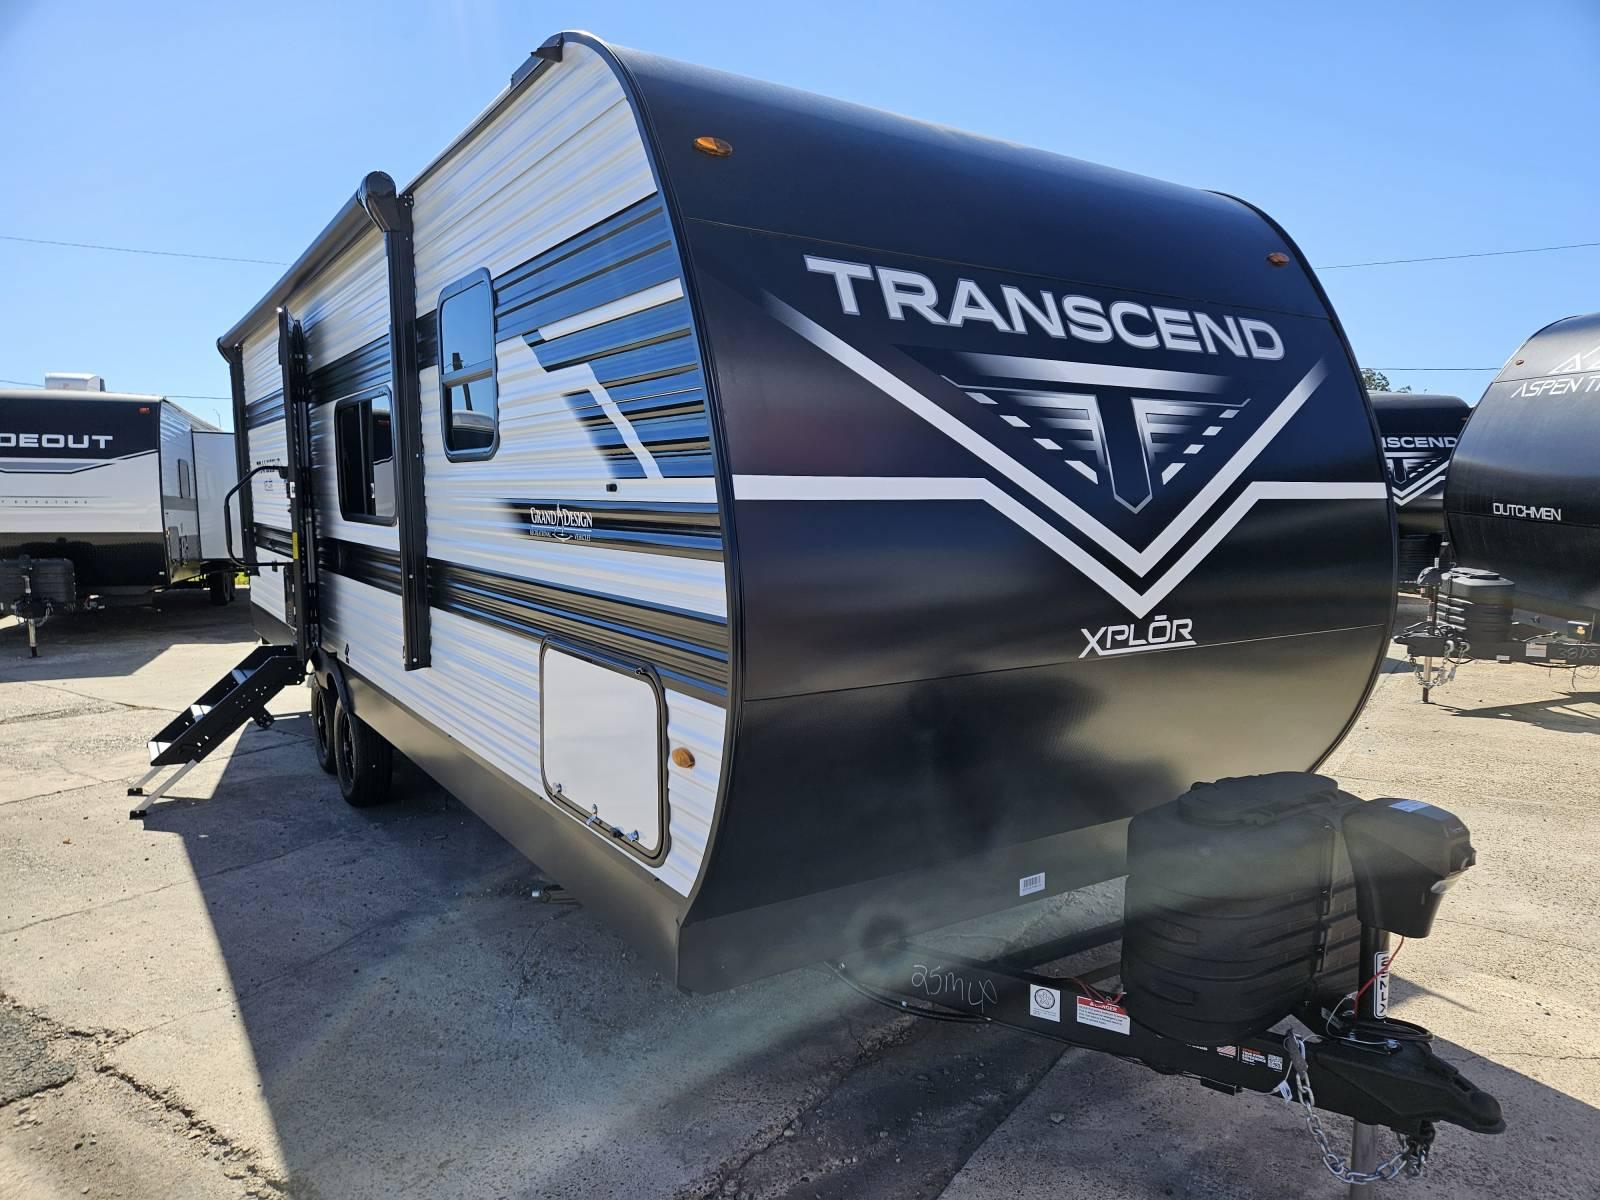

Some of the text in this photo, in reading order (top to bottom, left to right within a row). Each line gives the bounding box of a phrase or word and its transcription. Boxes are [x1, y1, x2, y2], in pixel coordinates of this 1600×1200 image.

[804, 255, 1285, 361] TRANSCEND
[1510, 374, 1600, 399] ASPEN T
[530, 507, 593, 528] GRAND DESIGN
[1492, 502, 1562, 521] DUTCHMEN
